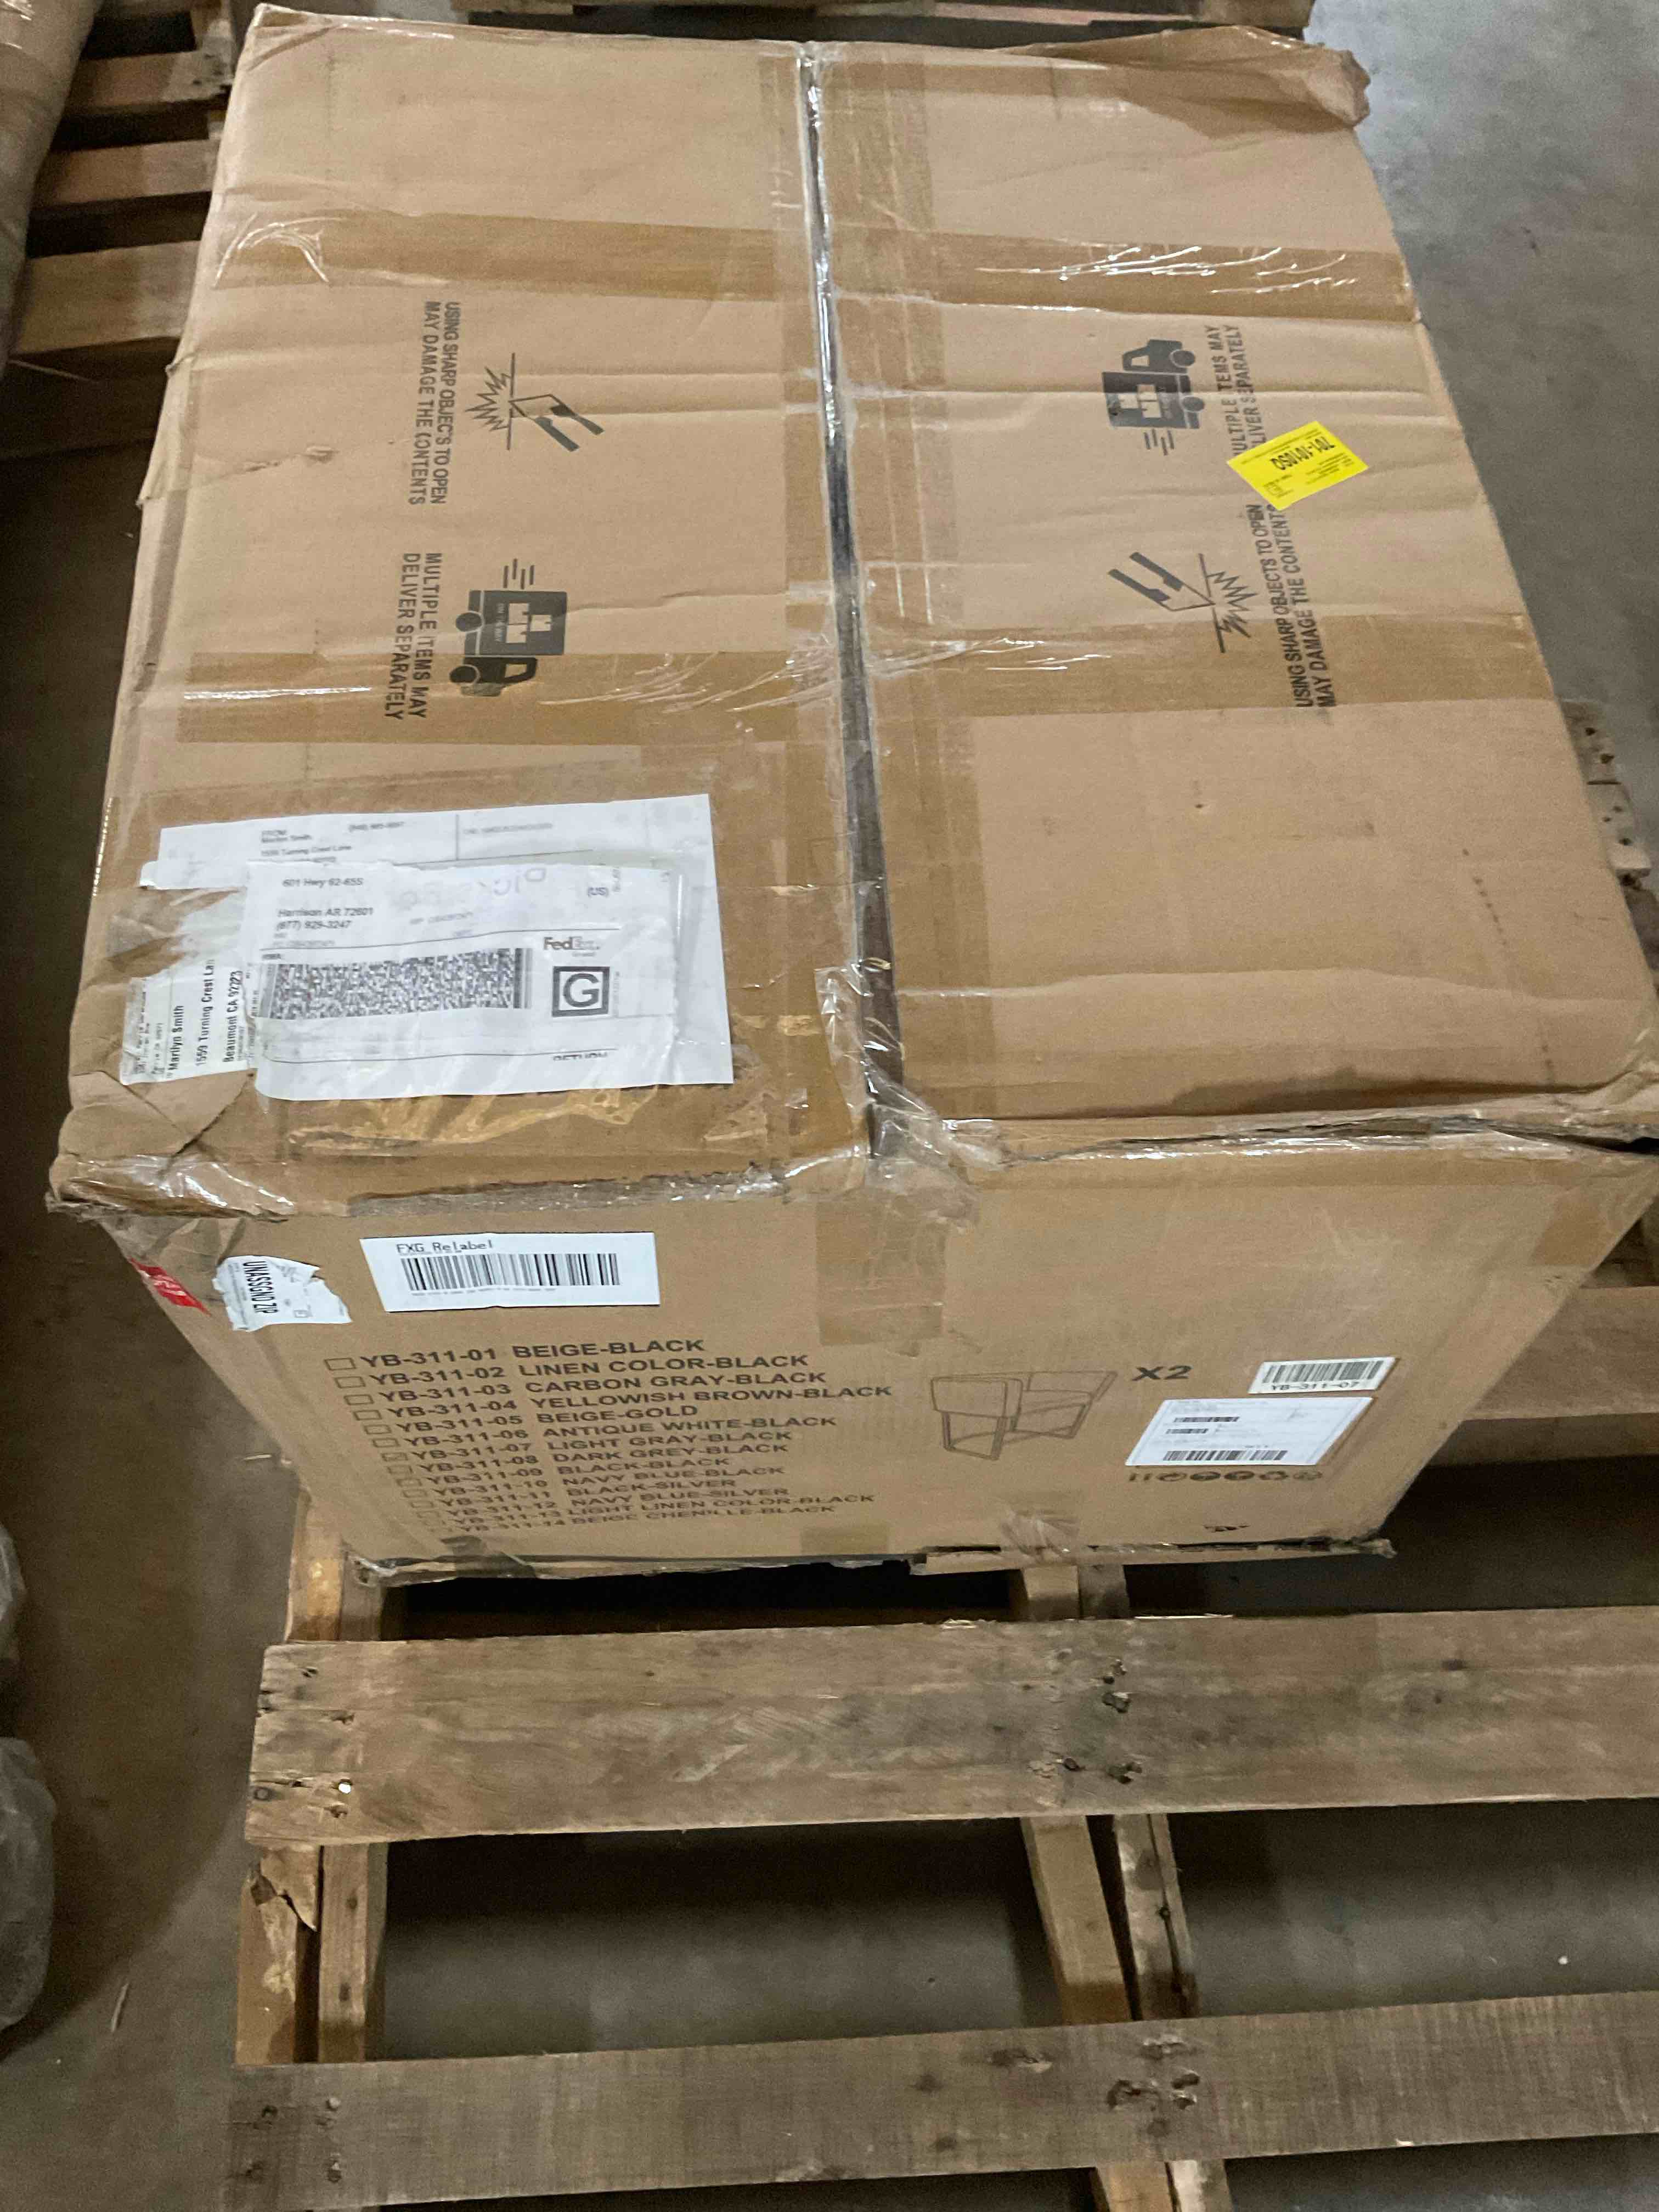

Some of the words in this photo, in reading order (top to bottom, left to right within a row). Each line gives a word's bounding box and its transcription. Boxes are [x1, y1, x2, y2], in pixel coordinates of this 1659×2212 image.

[424, 301, 442, 330] MAY
[444, 301, 461, 340] USING
[1205, 325, 1223, 351] MAY
[418, 334, 439, 394] DAMAGE
[441, 344, 459, 386] SHARP
[1212, 355, 1232, 392] TEMS
[416, 400, 434, 427] THE
[436, 389, 456, 445] OBJECS
[1222, 399, 1248, 455] ULTIPLE
[433, 448, 451, 465] TO
[430, 467, 448, 504] OPEN
[1246, 504, 1269, 537] OPEN
[1255, 539, 1272, 555] TO
[397, 552, 421, 619] DELIVER
[419, 552, 442, 630] MULTIPLE
[1260, 558, 1289, 614] OBJECTS
[1288, 578, 1310, 606] THE
[1276, 619, 1302, 662] SHARP
[1295, 610, 1328, 671] DAMAGE
[385, 624, 414, 720] SEPARATELY
[413, 636, 434, 681] ITEMS
[1288, 664, 1313, 707] USING
[1312, 675, 1337, 708] MAY
[408, 686, 429, 718] MAY
[303, 878, 326, 889] Hwy
[325, 908, 342, 916] AR
[201, 978, 215, 1003] Crest
[562, 973, 600, 1007] G
[172, 1005, 184, 1033] Smith
[227, 1000, 238, 1013] CA
[199, 1006, 213, 1042] Turning
[223, 1016, 238, 1062] Beaumont
[168, 1036, 184, 1070] Marilyn
[397, 1243, 425, 1254] FXG
[432, 1239, 493, 1252] Relabel
[242, 1261, 275, 1302] UNASSGND
[253, 1302, 279, 1313] ZIP
[360, 1348, 496, 1368] YB-311-01
[512, 1339, 704, 1358] BEIGE-BLACK
[370, 1366, 506, 1386] YB-311-02
[518, 1362, 601, 1376] LINEN
[608, 1354, 809, 1372] COLOR-BLACK
[1271, 1381, 1360, 1391] YB-311-07
[379, 1383, 512, 1402] YB-311-03
[525, 1377, 641, 1393] CARBON
[650, 1372, 826, 1387] GRAY-BLACK
[387, 1400, 518, 1418] YB-311-04
[531, 1391, 685, 1409] YELLOWISH
[693, 1386, 892, 1402] BROWN-BLACK
[396, 1414, 523, 1433] YB-311-05
[536, 1406, 698, 1424] BEIGE-GOLD
[403, 1429, 529, 1447] YB-311-06
[543, 1423, 655, 1437] ANTIQUE
[660, 1417, 837, 1430] WHITE-BLACK
[411, 1442, 532, 1460] YB-311-07
[547, 1438, 621, 1450] LIGHT
[629, 1432, 792, 1446] GRAY-BLACK
[419, 1455, 539, 1472] YB-311-08
[552, 1452, 623, 1462] DARK
[629, 1444, 788, 1457] GREY-BLACK
[426, 1468, 543, 1485] YB-311-09
[557, 1458, 729, 1475] BLACK-BLACK
[431, 1480, 548, 1496] YB-311-10
[562, 1474, 625, 1485] NAVY
[634, 1468, 785, 1480] BLUE-BLACK
